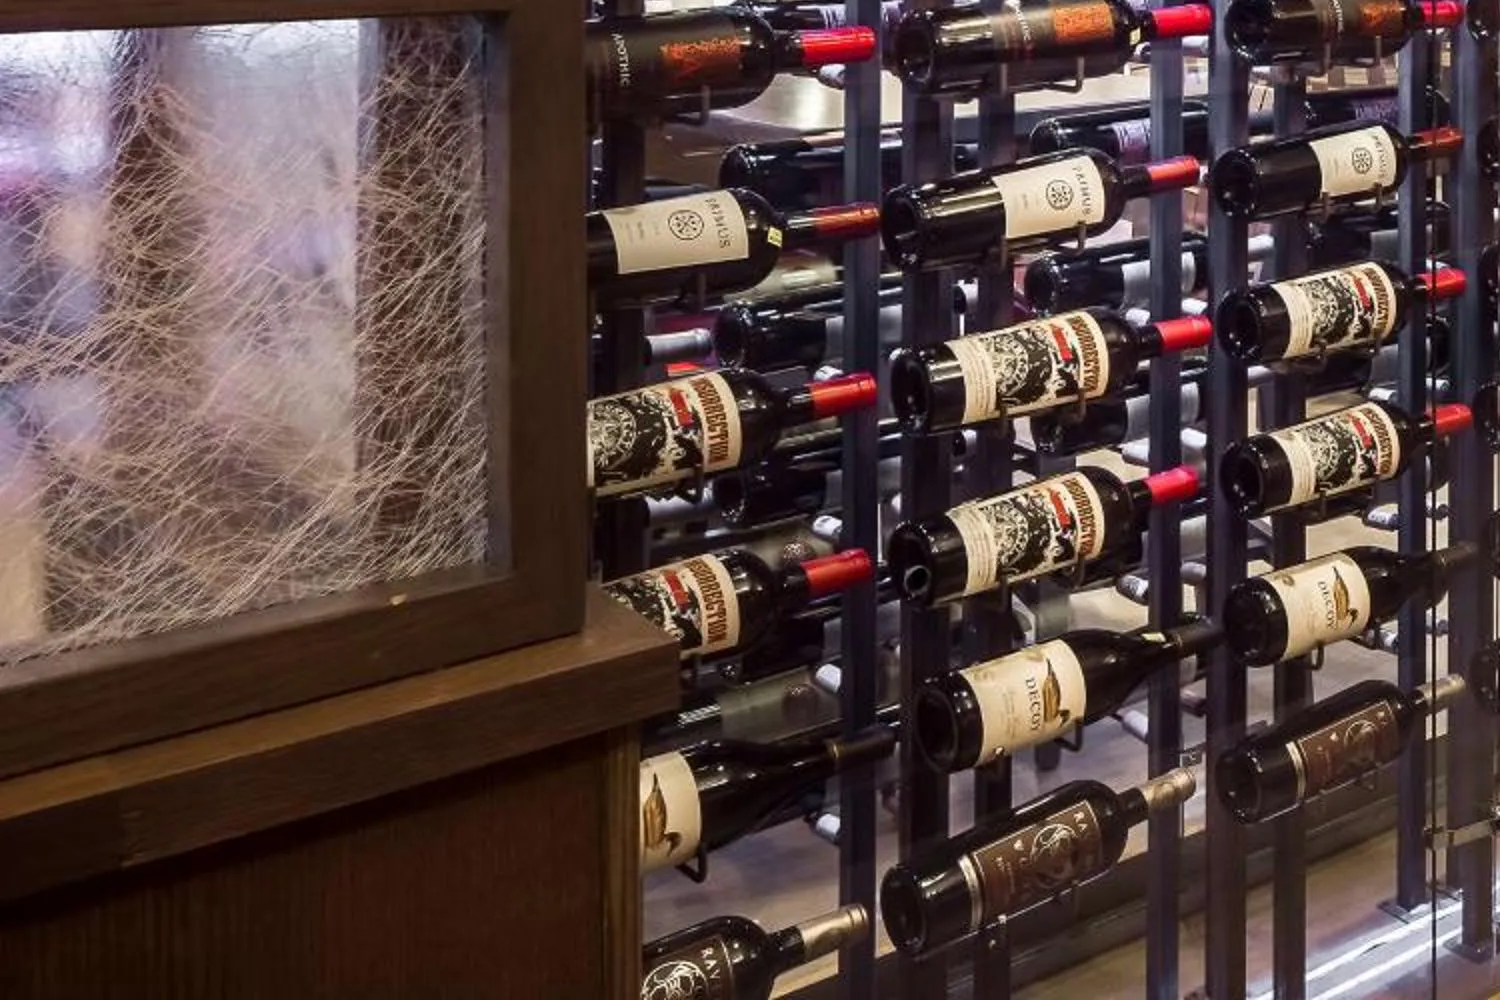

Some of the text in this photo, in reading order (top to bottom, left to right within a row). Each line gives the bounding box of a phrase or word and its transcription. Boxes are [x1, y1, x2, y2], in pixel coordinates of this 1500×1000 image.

[611, 32, 632, 87] APOTHIC
[1072, 165, 1094, 217] PRIMUS
[704, 195, 732, 249] PRIMUS
[1317, 580, 1337, 631] DECOY
[1023, 677, 1043, 733] DECOY
